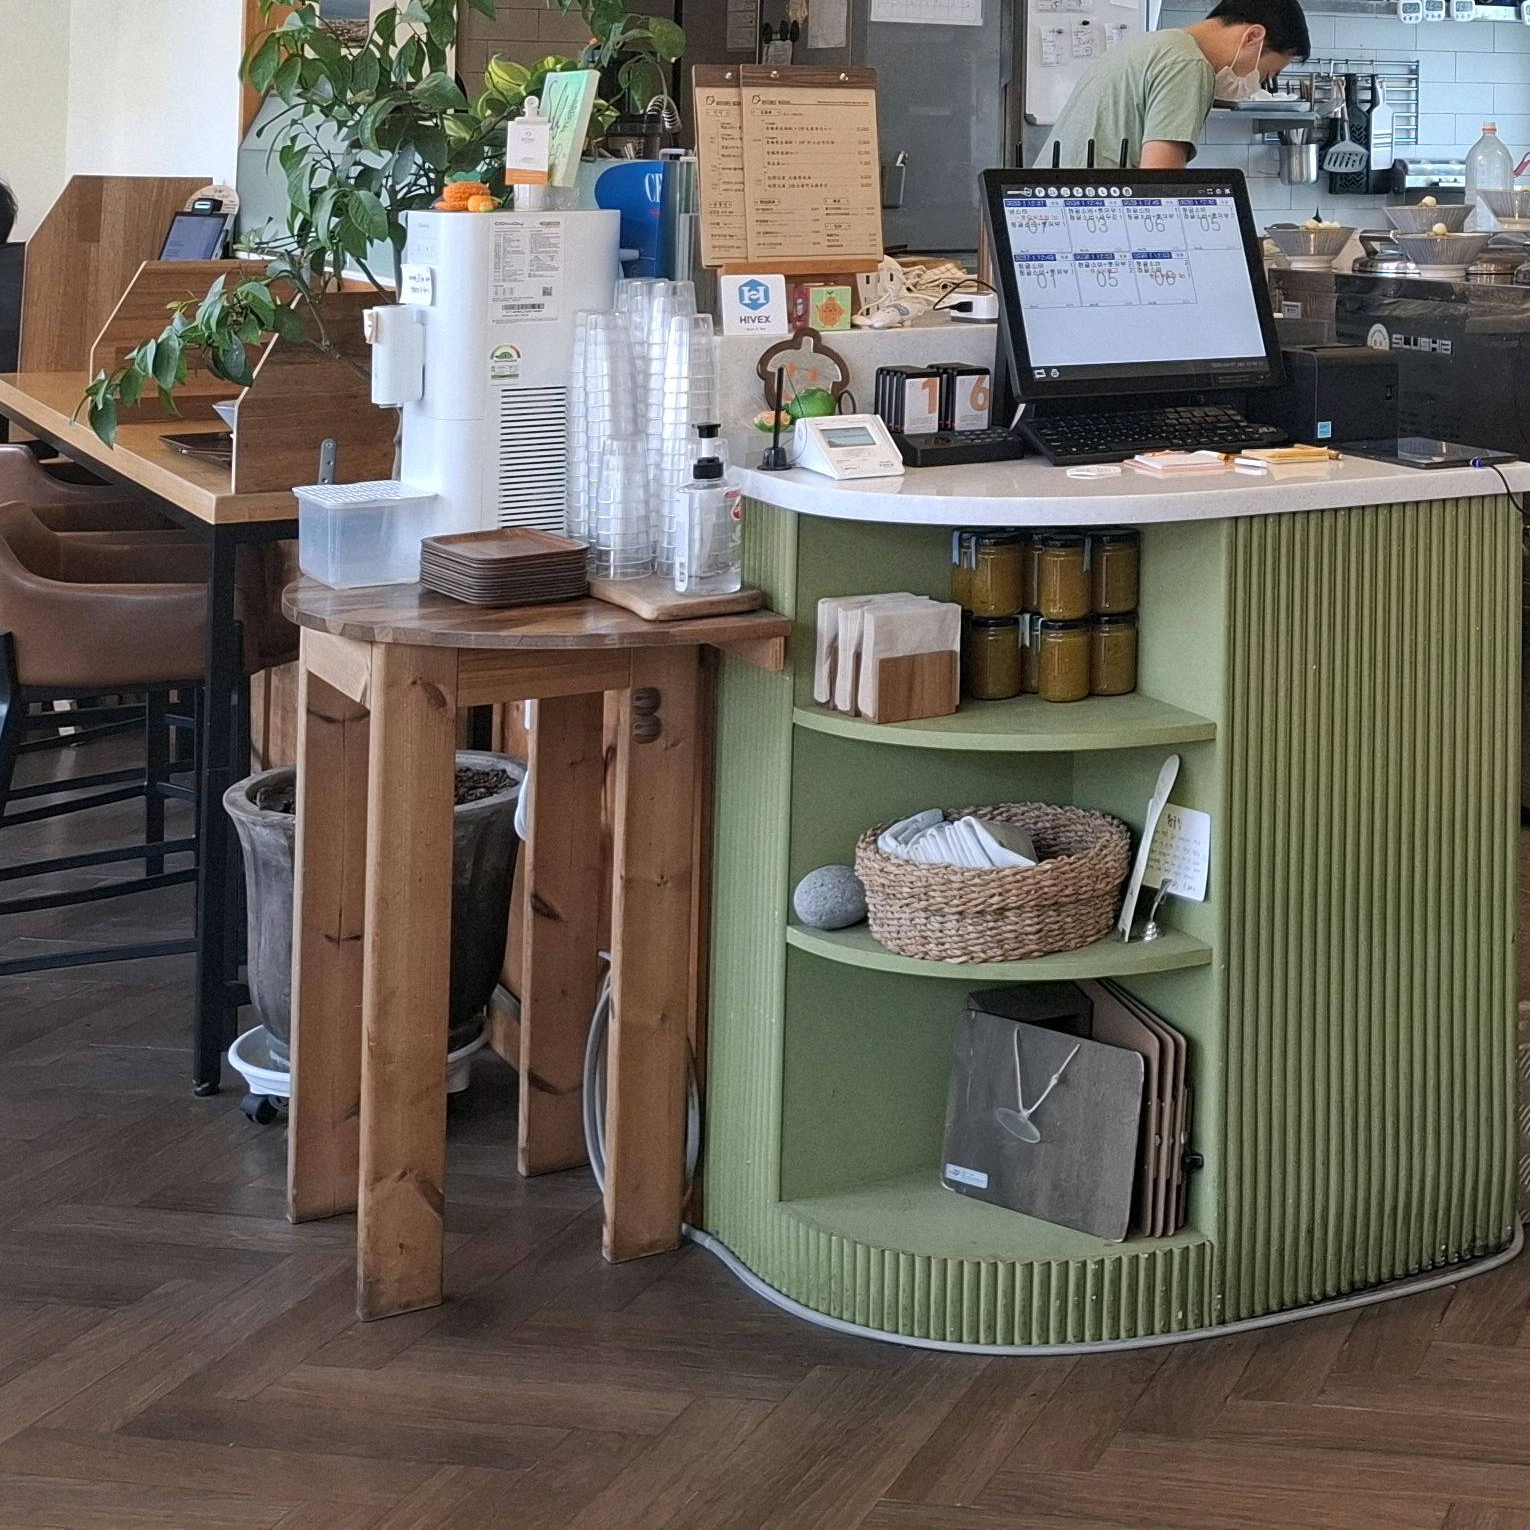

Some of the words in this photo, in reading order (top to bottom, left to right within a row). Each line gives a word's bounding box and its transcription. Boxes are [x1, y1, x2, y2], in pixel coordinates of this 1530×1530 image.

[1144, 217, 1165, 233] 06
[1201, 217, 1221, 232] 05
[740, 315, 771, 324] HIVEX
[922, 377, 938, 415] 1
[970, 375, 991, 411] 6
